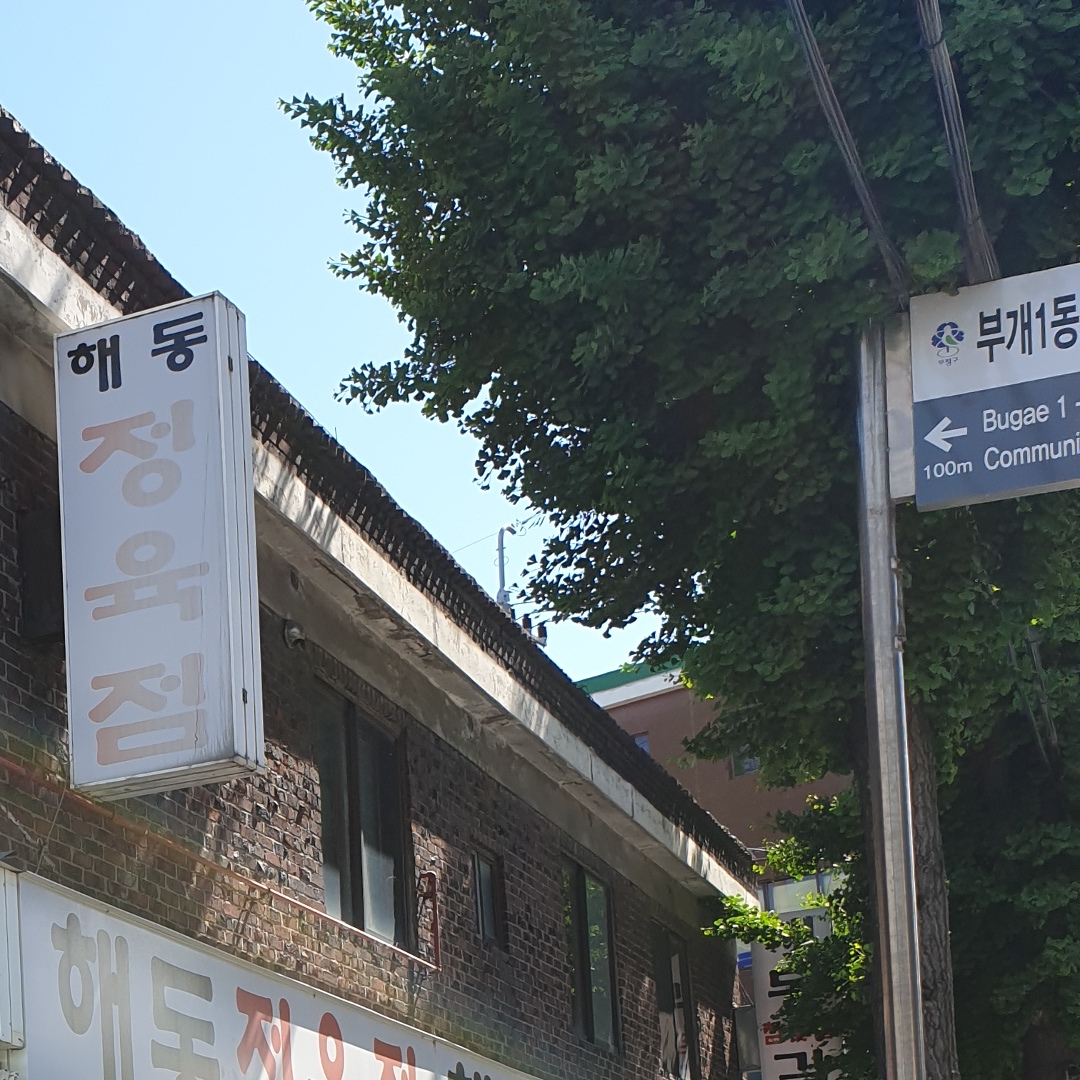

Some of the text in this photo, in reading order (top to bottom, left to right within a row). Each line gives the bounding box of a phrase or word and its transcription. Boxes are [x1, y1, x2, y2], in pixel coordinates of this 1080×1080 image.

[983, 404, 1049, 432] Bugae
[924, 460, 973, 480] 100m
[79, 399, 210, 766] 정육점
